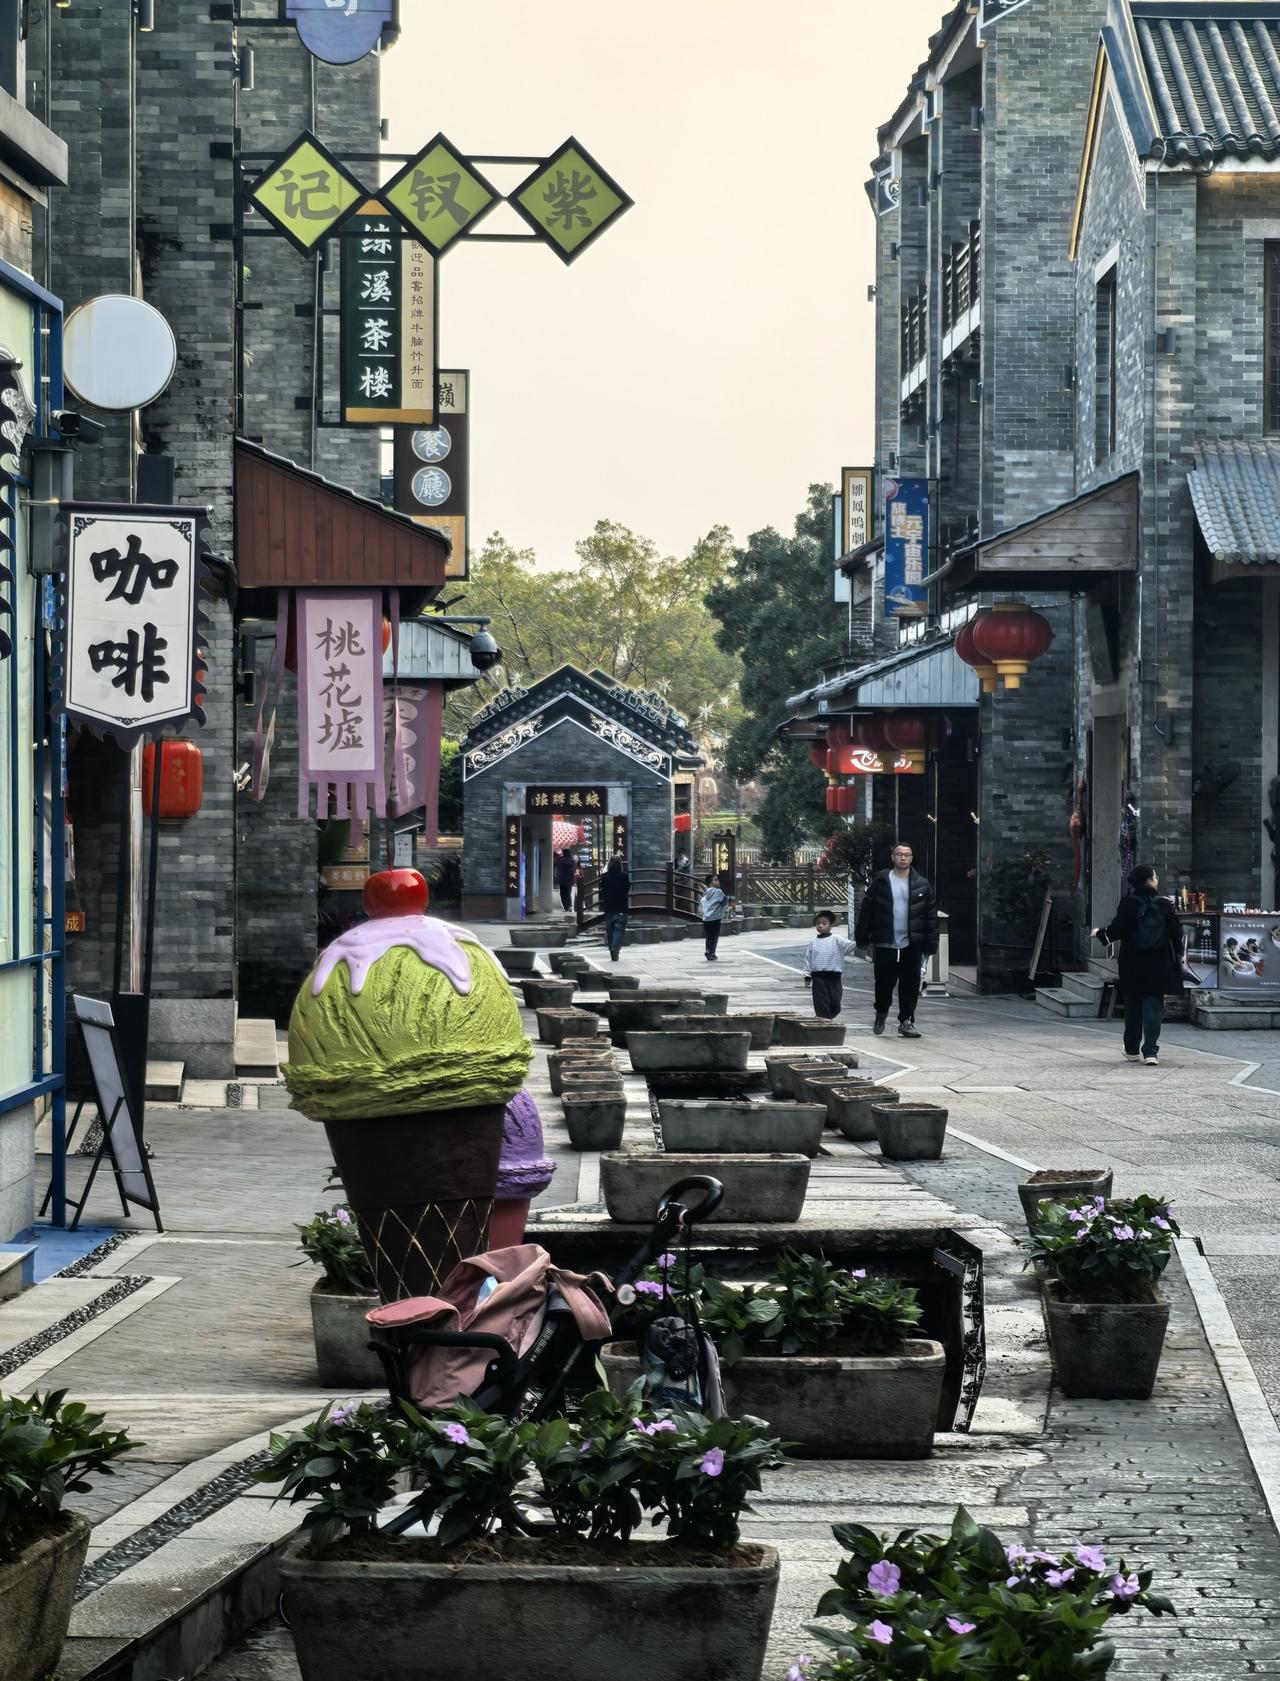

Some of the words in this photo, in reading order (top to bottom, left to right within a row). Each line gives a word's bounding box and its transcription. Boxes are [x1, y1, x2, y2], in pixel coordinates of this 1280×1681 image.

[275, 168, 598, 231] 紫钗记
[88, 534, 179, 702] 咖啡
[315, 617, 365, 753] 桃花墟
